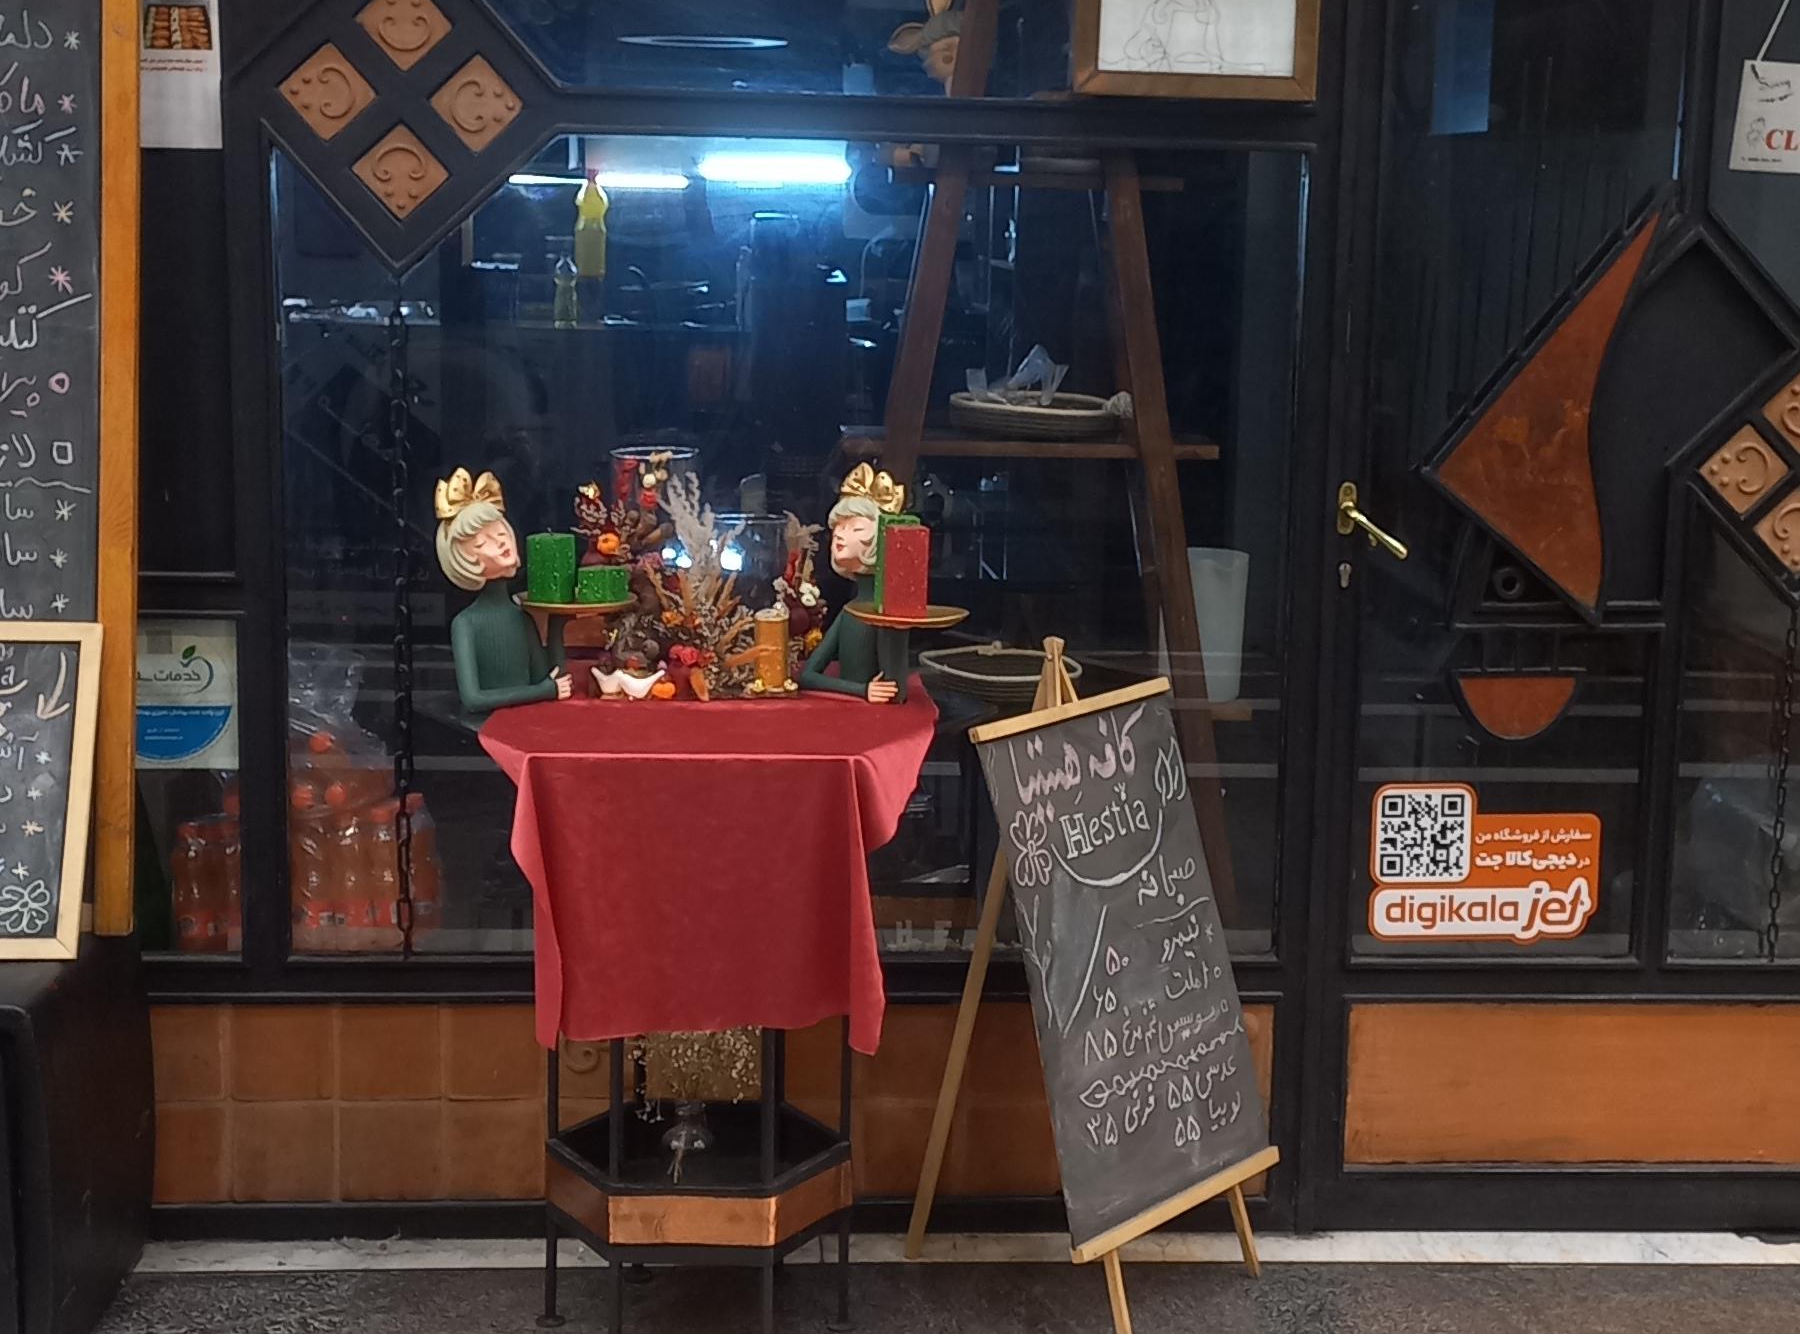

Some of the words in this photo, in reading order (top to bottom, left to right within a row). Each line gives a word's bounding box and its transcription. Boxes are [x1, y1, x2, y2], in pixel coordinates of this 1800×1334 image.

[1059, 799, 1150, 860] Hestia
[1475, 833, 1492, 844] من
[1493, 828, 1540, 843] فروشگاه
[1539, 829, 1550, 843] از
[1550, 828, 1592, 843] سفارش
[1475, 852, 1503, 870] جت
[1576, 857, 1591, 869] در
[1385, 894, 1519, 930] digikala
[1520, 884, 1585, 932] jet
[1084, 1028, 1117, 1066] ۸۵
[1167, 1074, 1194, 1110] ۵۵
[1174, 1115, 1201, 1147] ۵۵
